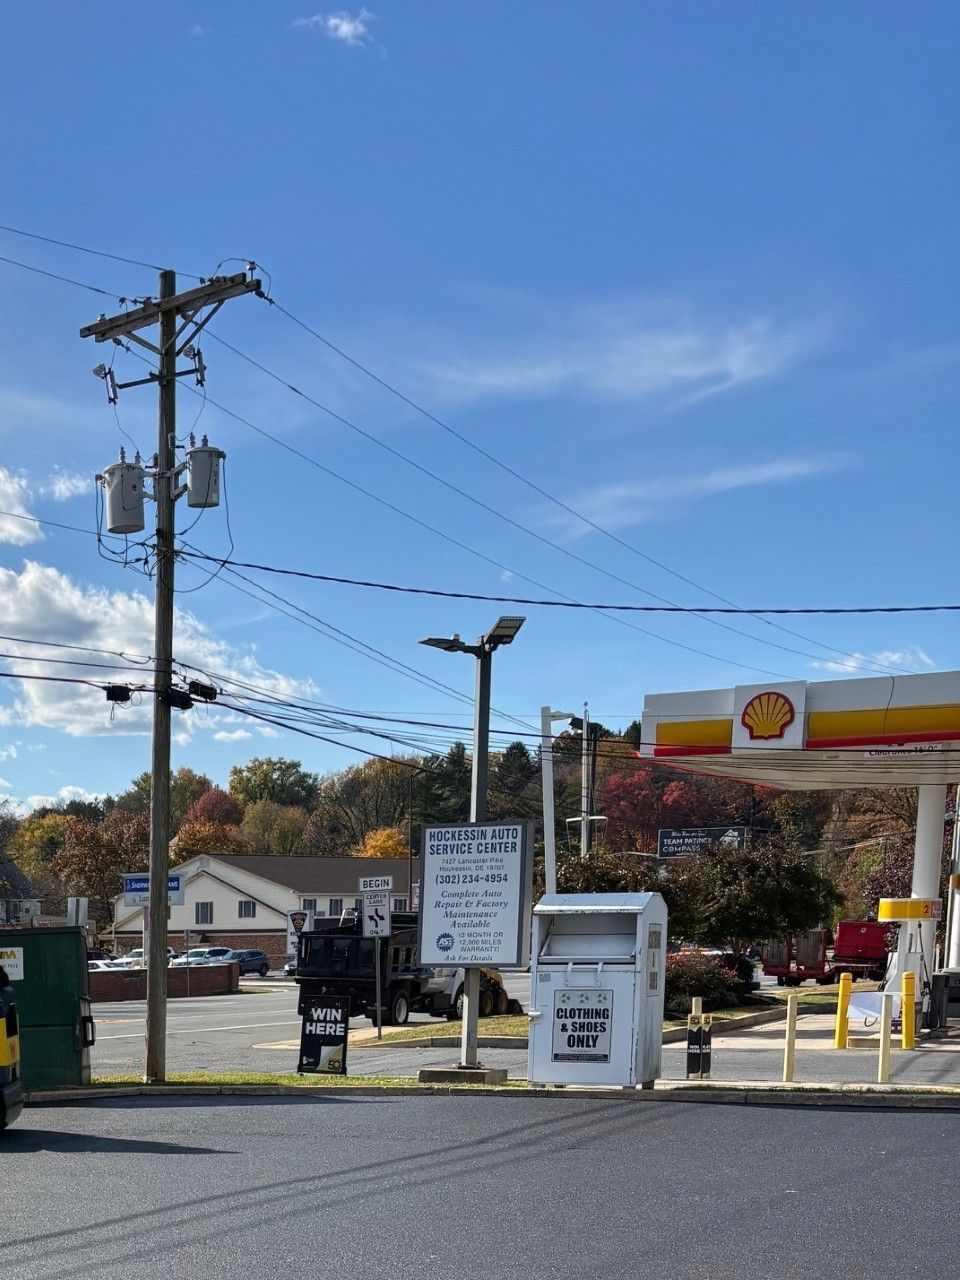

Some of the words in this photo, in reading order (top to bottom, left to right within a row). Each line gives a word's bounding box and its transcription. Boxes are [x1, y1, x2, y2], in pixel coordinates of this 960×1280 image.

[429, 829, 487, 842] HOCKESSIN
[491, 827, 518, 840] AUTO
[429, 842, 473, 855] SERVICE
[477, 841, 517, 854] CENTER
[662, 845, 701, 853] COMPASS
[362, 879, 390, 889] BEGIN
[441, 889, 480, 899] Complete
[481, 889, 502, 897] Auto
[434, 900, 463, 909] Repair
[465, 900, 473, 908] &
[476, 900, 508, 909] Factory
[924, 904, 929, 913] 2
[443, 910, 498, 918] Maintenance
[450, 920, 490, 928] Available
[311, 1007, 343, 1021] WIN
[556, 1007, 610, 1020] CLOTHING
[305, 1022, 346, 1036] HERE
[560, 1022, 568, 1033] &
[571, 1021, 607, 1033] SHOES
[566, 1033, 600, 1048] ONLY
